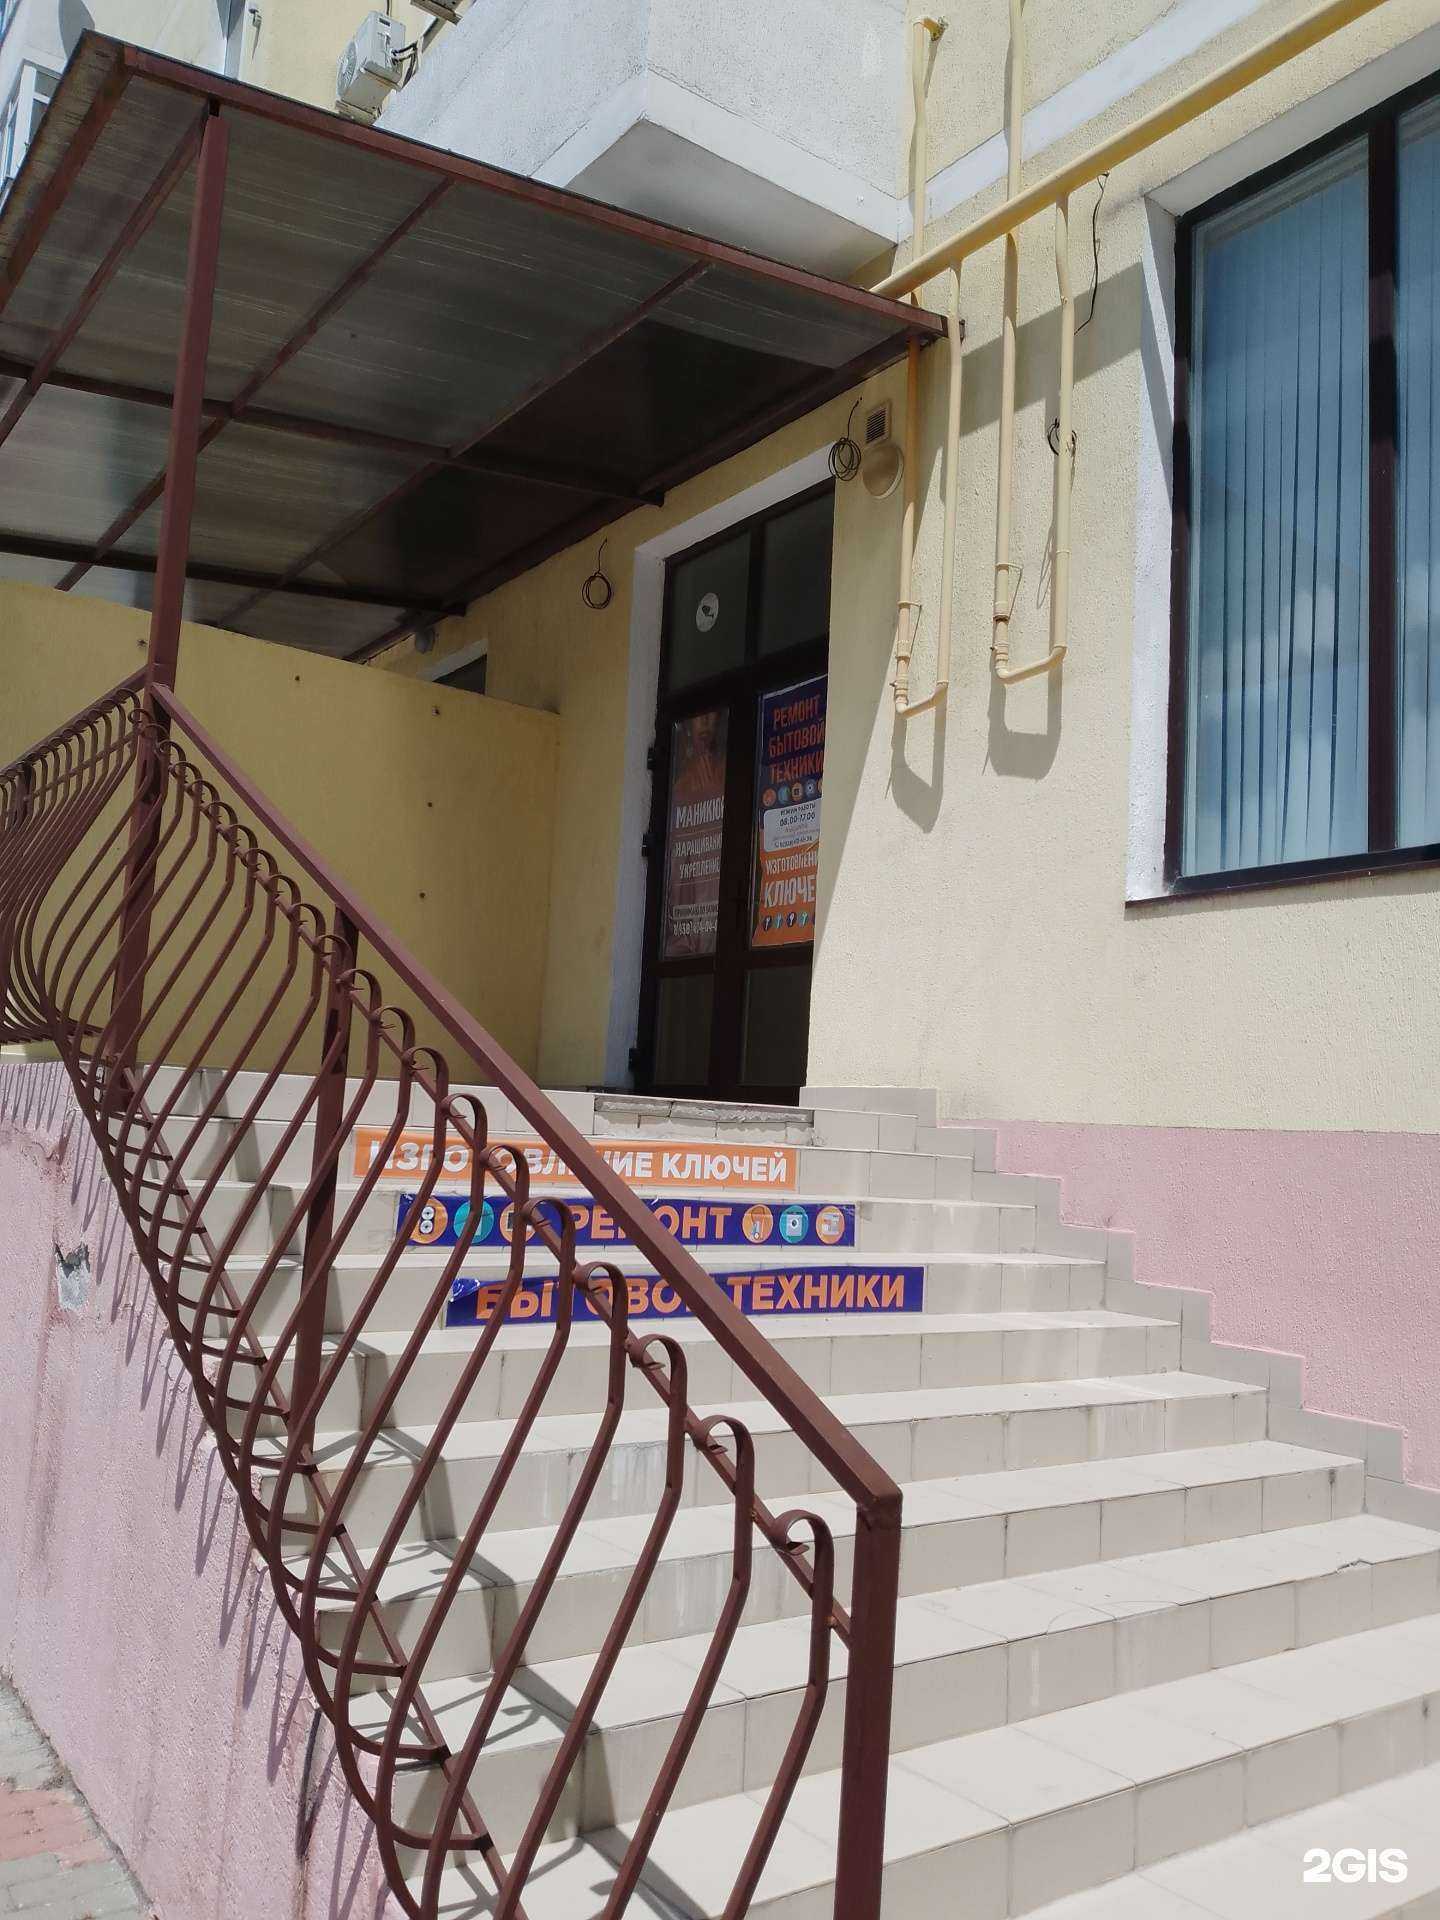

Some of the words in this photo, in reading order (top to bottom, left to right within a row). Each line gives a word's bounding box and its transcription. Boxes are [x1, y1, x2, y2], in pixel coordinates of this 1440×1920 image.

[773, 694, 822, 730] РЕМОНТ
[769, 750, 824, 784] ТЕХНИКИ
[764, 875, 816, 908] КЛЮЧЕ
[661, 1150, 788, 1183] КЛЮЧЕЙ
[571, 1203, 733, 1240] РЕОНТ
[727, 1273, 905, 1310] ТЕХНИКИ
